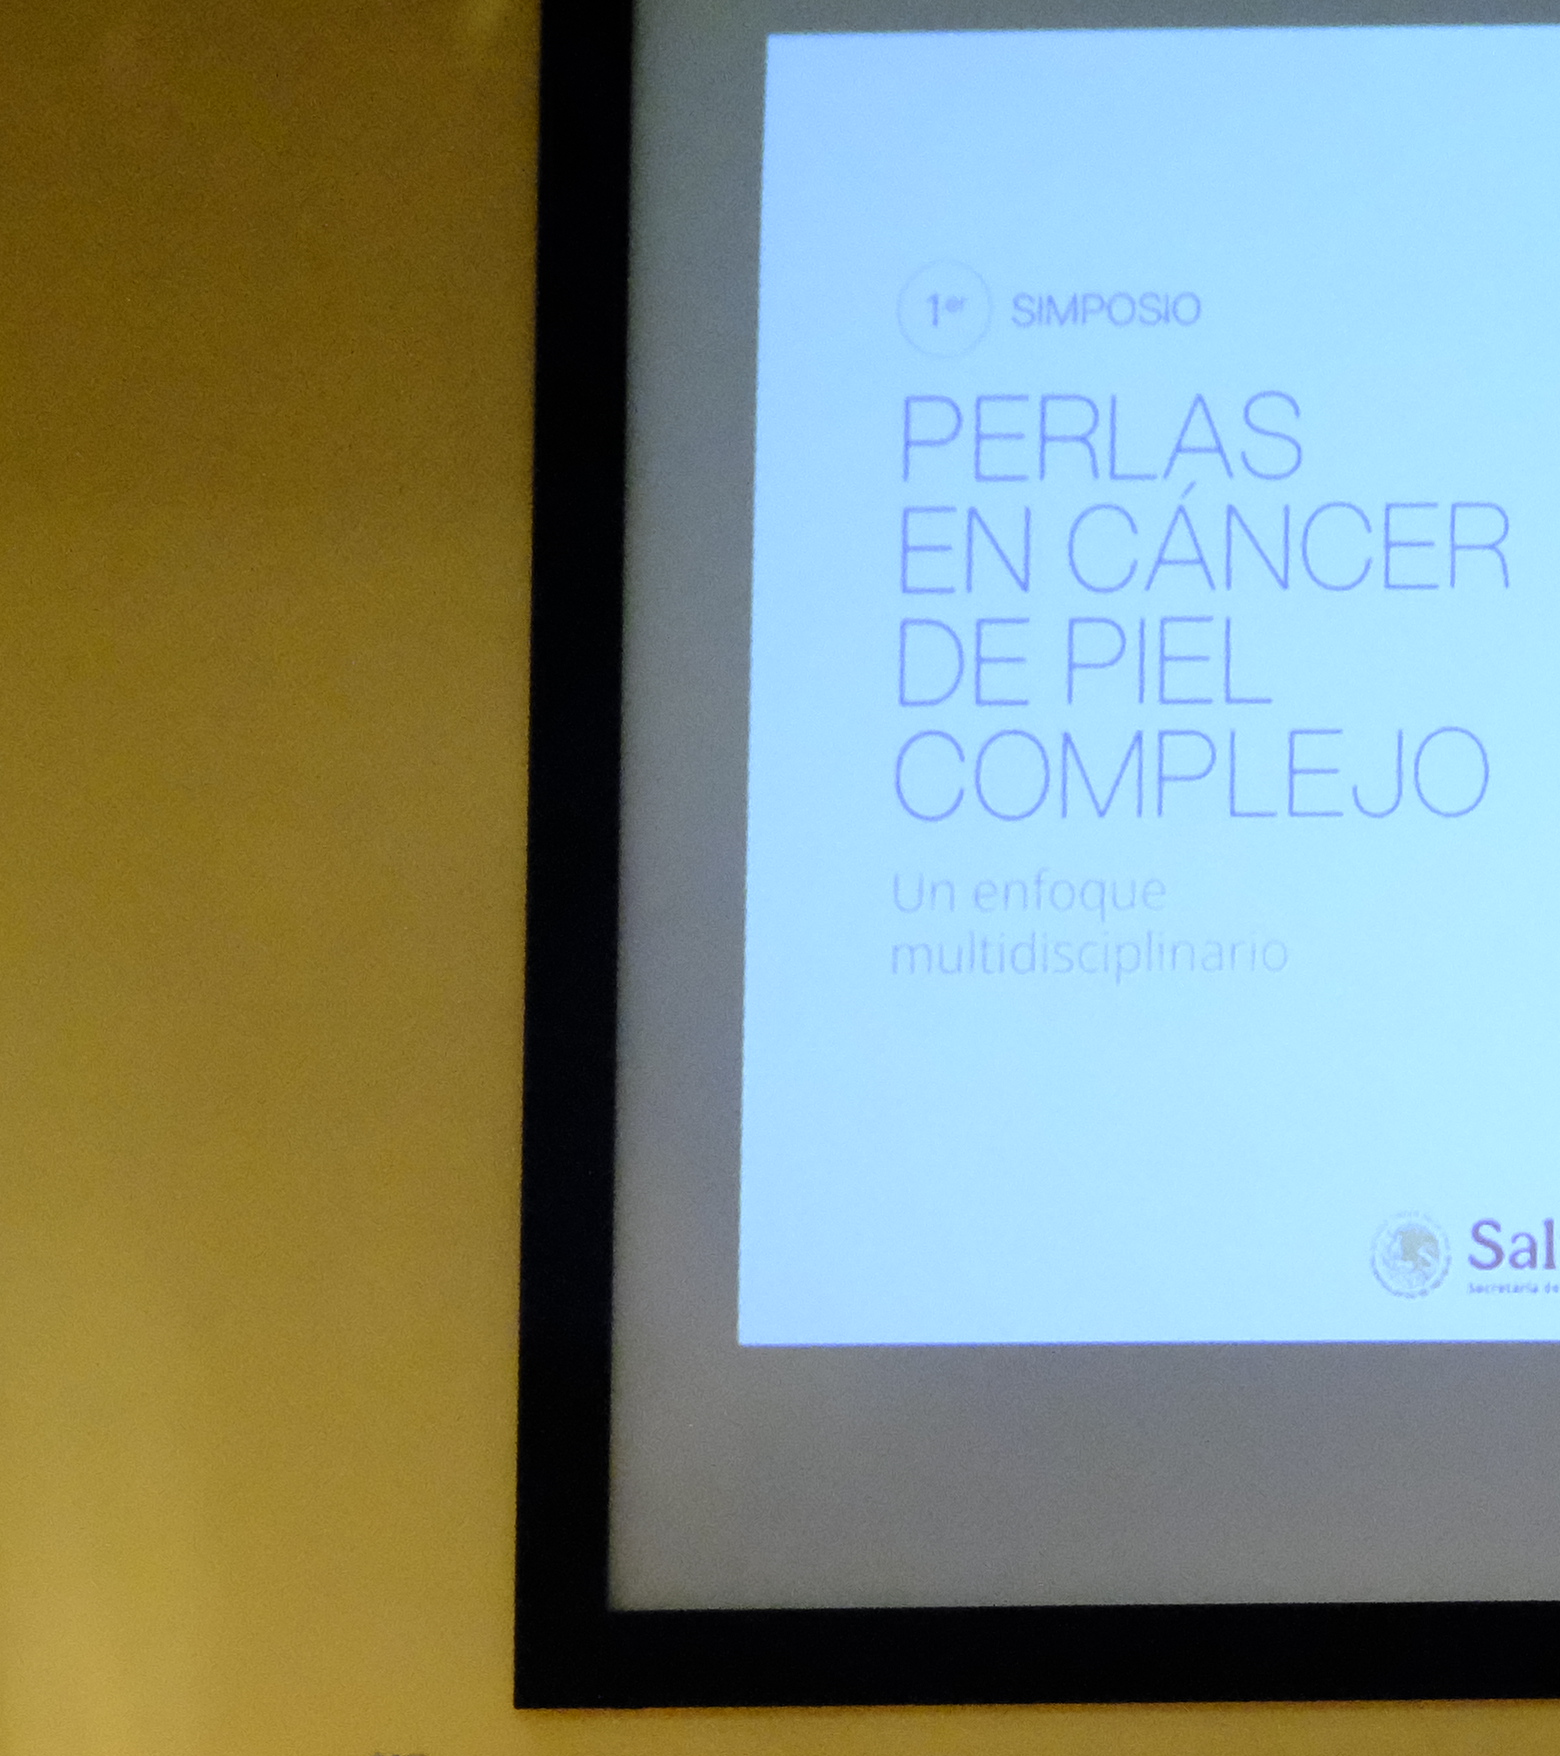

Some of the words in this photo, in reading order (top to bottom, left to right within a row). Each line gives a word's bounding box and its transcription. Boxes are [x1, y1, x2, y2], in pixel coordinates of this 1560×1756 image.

[1010, 290, 1203, 329] SIMPOSIO
[901, 389, 1304, 482] PERLAS
[899, 503, 1033, 595] EN
[1067, 480, 1511, 593] CÁNCER
[897, 616, 1031, 708] DE
[1067, 614, 1274, 706] PIEL
[894, 725, 1490, 823] COMPLEJO
[891, 871, 956, 914] Un
[972, 866, 1168, 923] enfoque
[890, 929, 1291, 986] multidisciplinario
